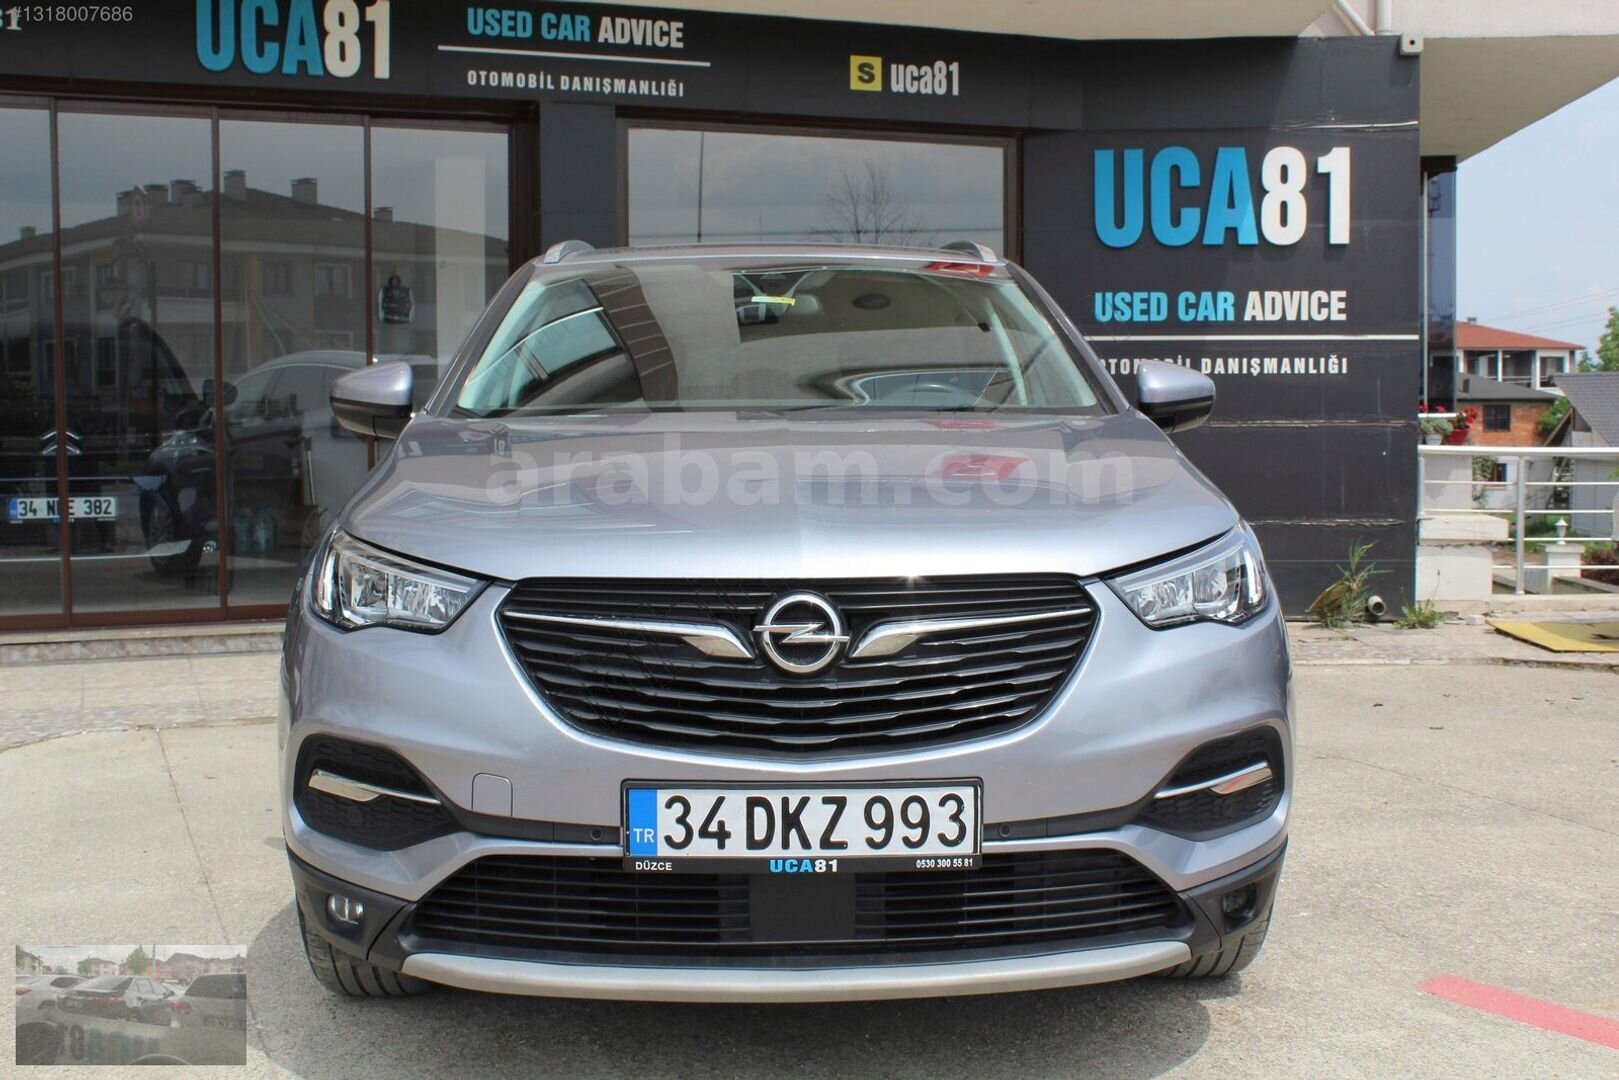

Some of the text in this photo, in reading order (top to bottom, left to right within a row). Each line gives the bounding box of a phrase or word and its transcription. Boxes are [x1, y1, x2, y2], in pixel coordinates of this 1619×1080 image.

[195, 0, 391, 79] UCA81
[466, 7, 685, 49] USED CAR ADVICE
[466, 69, 685, 98] OTOMOBİL DANIŞMANLIĞI
[857, 60, 960, 97] S uca81
[1093, 145, 1351, 248] UCA81
[1093, 289, 1348, 323] USED CAR ADVICE
[1200, 353, 1349, 377] DANIŞMANLIĞI
[18, 500, 38, 517] 34
[46, 500, 76, 516] NE
[83, 499, 113, 515] 382
[633, 792, 967, 851] TR 34 DKZ 993
[635, 860, 673, 871] DÜZCE
[769, 858, 839, 873] UCA81
[915, 857, 973, 869] 0530 300 55 81
